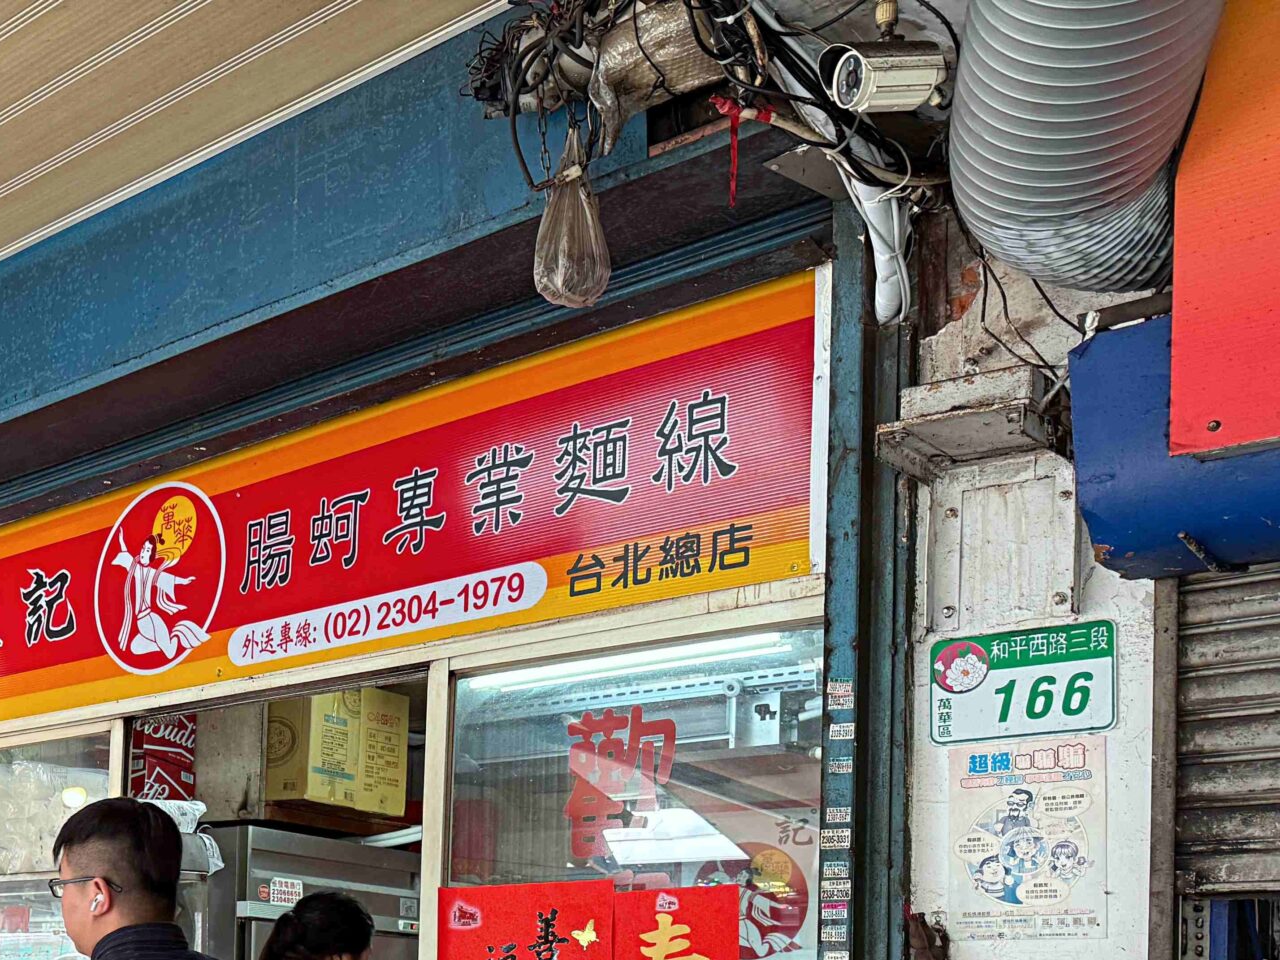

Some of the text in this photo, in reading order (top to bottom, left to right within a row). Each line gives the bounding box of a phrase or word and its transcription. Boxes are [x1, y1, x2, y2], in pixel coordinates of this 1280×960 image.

[240, 388, 738, 595] 腸蚵專業麵線
[565, 522, 755, 598] 台北總店
[241, 572, 524, 659] 外送專線: (02) 2304-1979
[990, 626, 1108, 663] 和平西路三段
[937, 697, 952, 738] 萬華區
[994, 671, 1094, 723] 166
